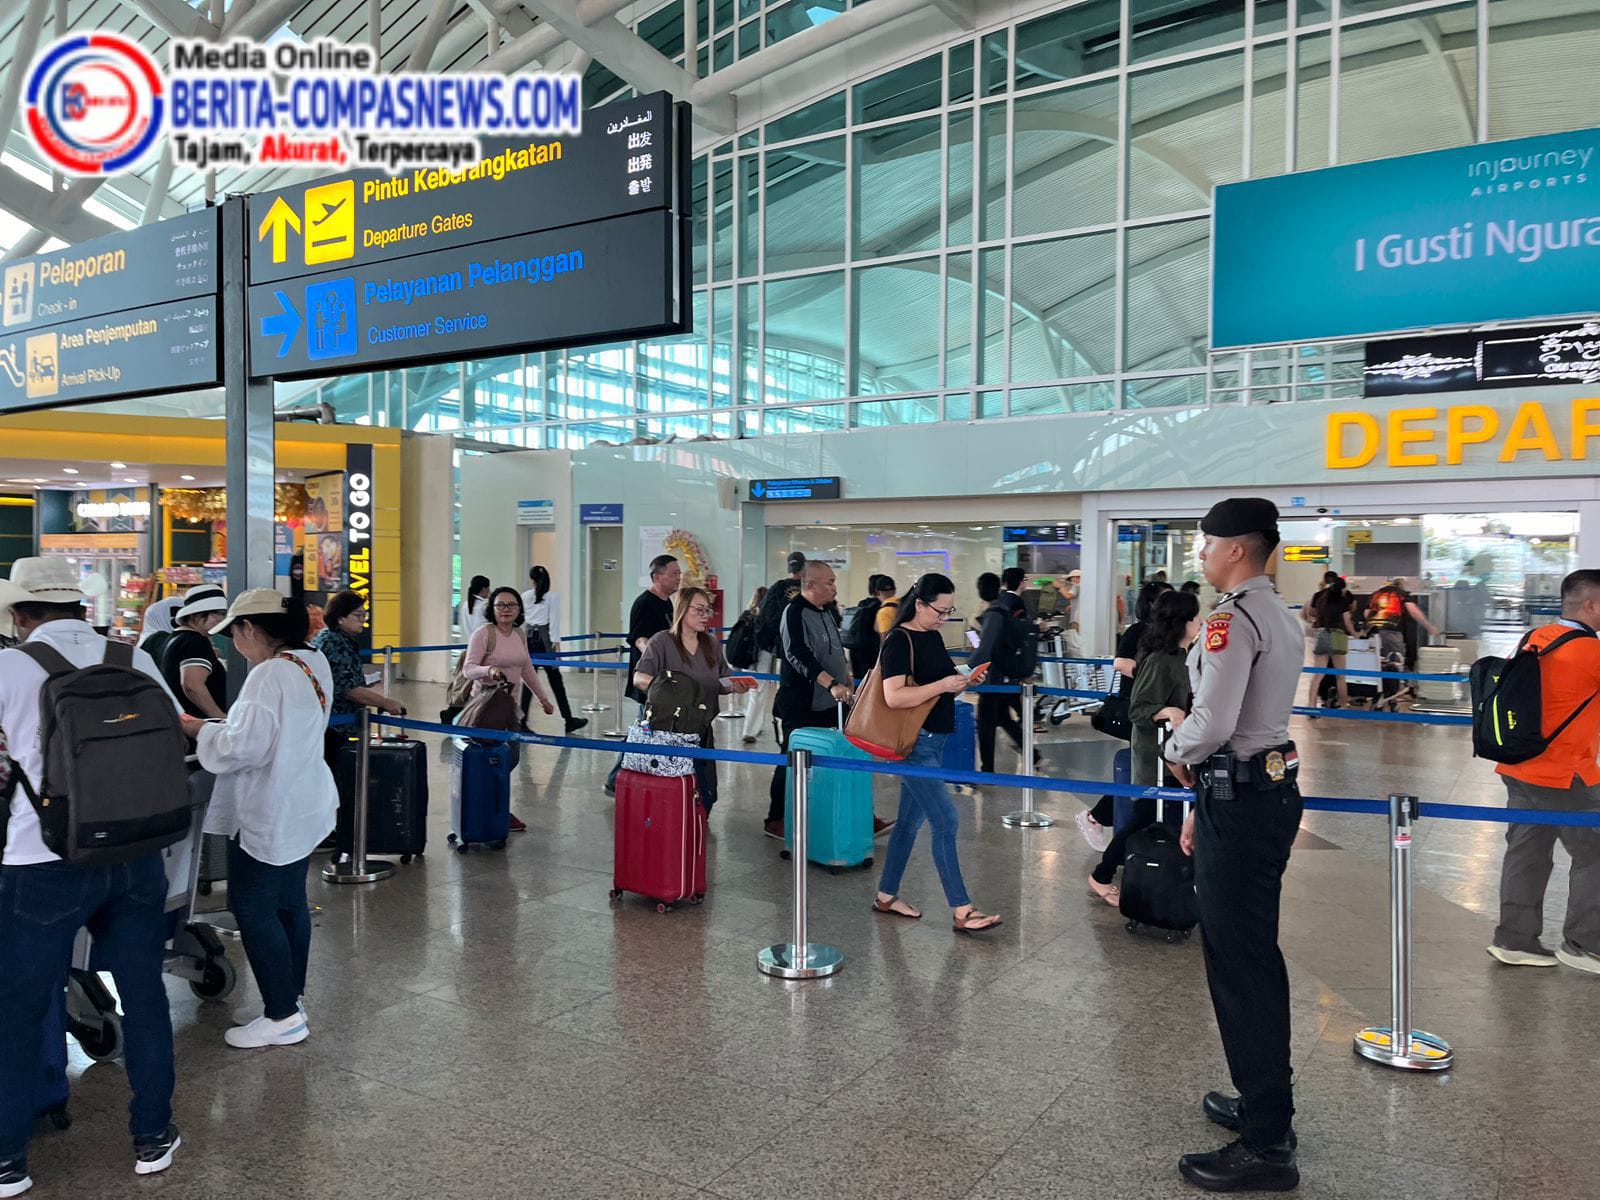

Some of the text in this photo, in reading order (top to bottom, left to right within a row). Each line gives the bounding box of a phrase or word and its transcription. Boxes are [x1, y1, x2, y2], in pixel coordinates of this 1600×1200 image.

[627, 131, 653, 149] 出发
[627, 153, 653, 174] 出発
[363, 179, 409, 203] Pintu
[627, 177, 653, 196] 출발
[1470, 173, 1588, 198] AIRPORTS
[363, 213, 473, 248] Departure Gates
[1355, 238, 1365, 272] I
[1376, 222, 1473, 268] Gusti
[40, 249, 125, 287] Pelaporan
[365, 250, 583, 304] Pelayanan Pelanggan
[60, 319, 157, 350] Area Penjemputan
[368, 313, 488, 344] Customer Service
[88, 366, 121, 382] Pick-Up
[349, 473, 370, 507] GO
[349, 511, 370, 543] TO
